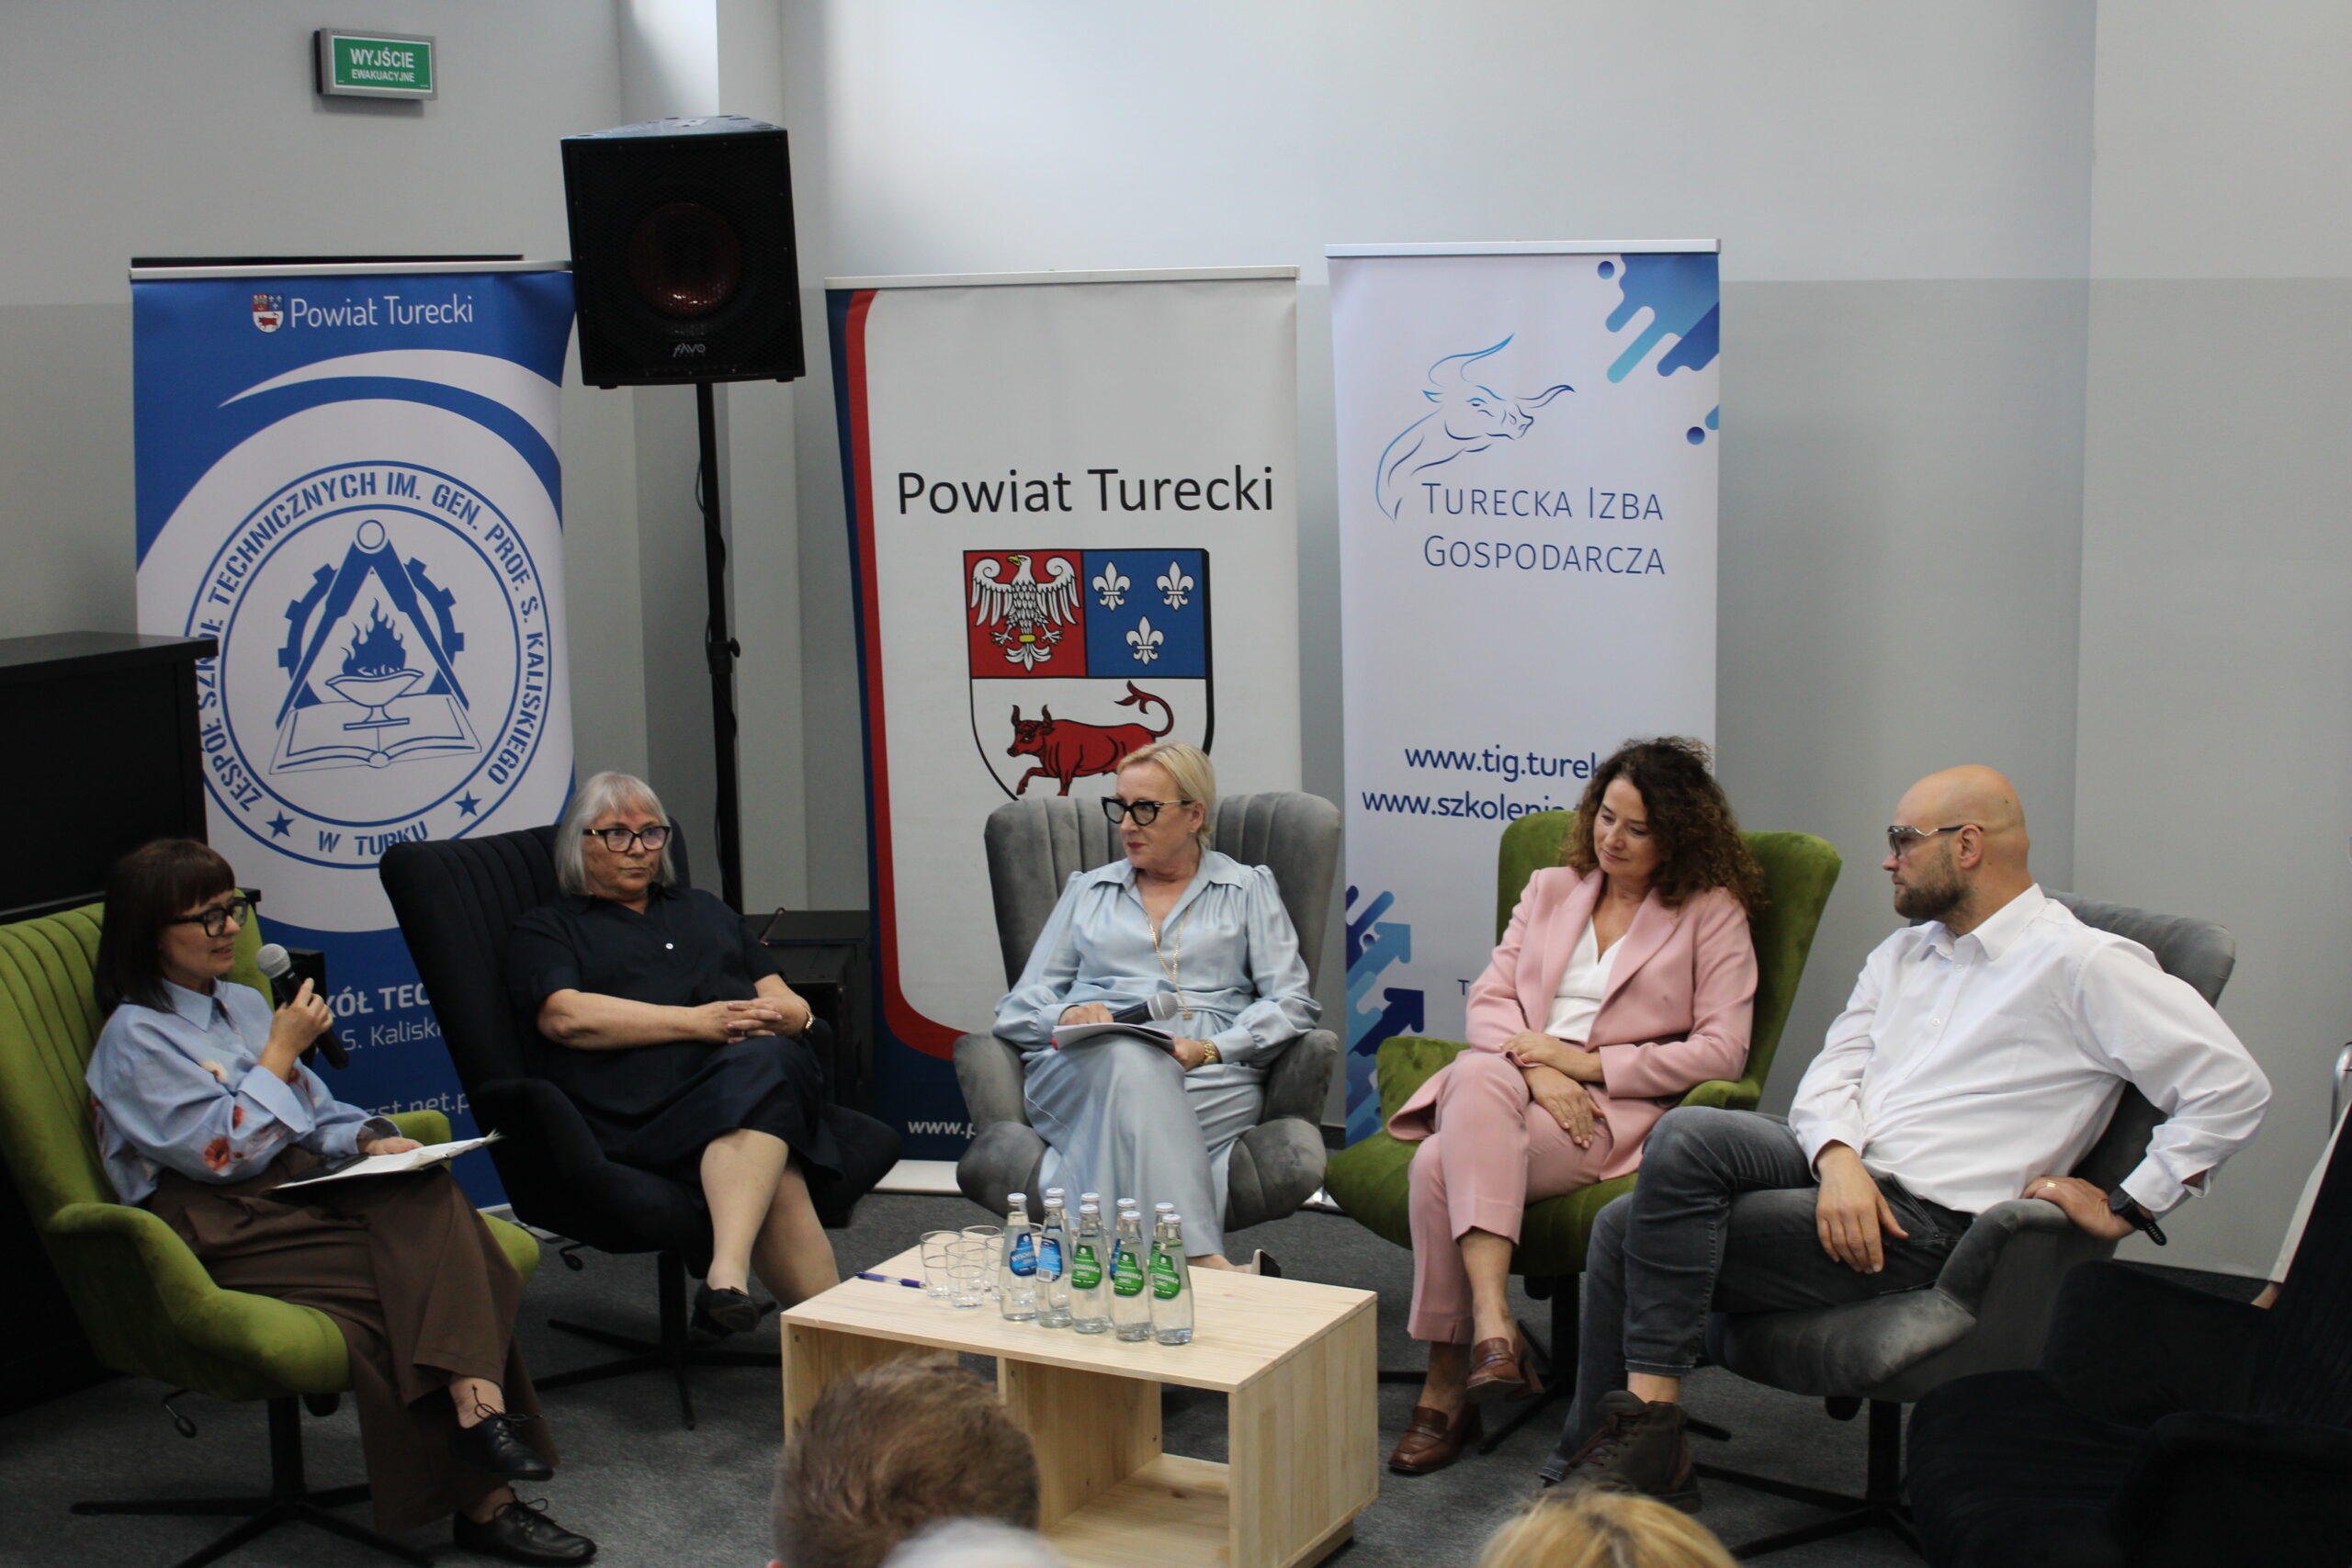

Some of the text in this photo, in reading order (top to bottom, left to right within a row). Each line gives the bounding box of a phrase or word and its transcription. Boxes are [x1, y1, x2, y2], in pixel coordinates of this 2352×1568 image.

[350, 47, 415, 69] WYJŚCIE
[351, 68, 415, 83] EWAKUACYJNE
[290, 293, 473, 328] Powiat Turecki
[387, 472, 422, 501] IM.
[898, 465, 1274, 515] Powiat Turecki
[1421, 482, 1664, 521] TURECKA IZBA
[432, 483, 481, 531] GEN.
[208, 472, 377, 605] TECHNICZNYCH
[484, 523, 531, 592] PROF.
[1424, 535, 1666, 575] GOSPODARCZA
[520, 596, 538, 624] S.
[487, 632, 545, 785] KALISKIEGO
[200, 717, 264, 813] ZESPÓŁ
[319, 830, 341, 853] W
[342, 1029, 363, 1052] S.
